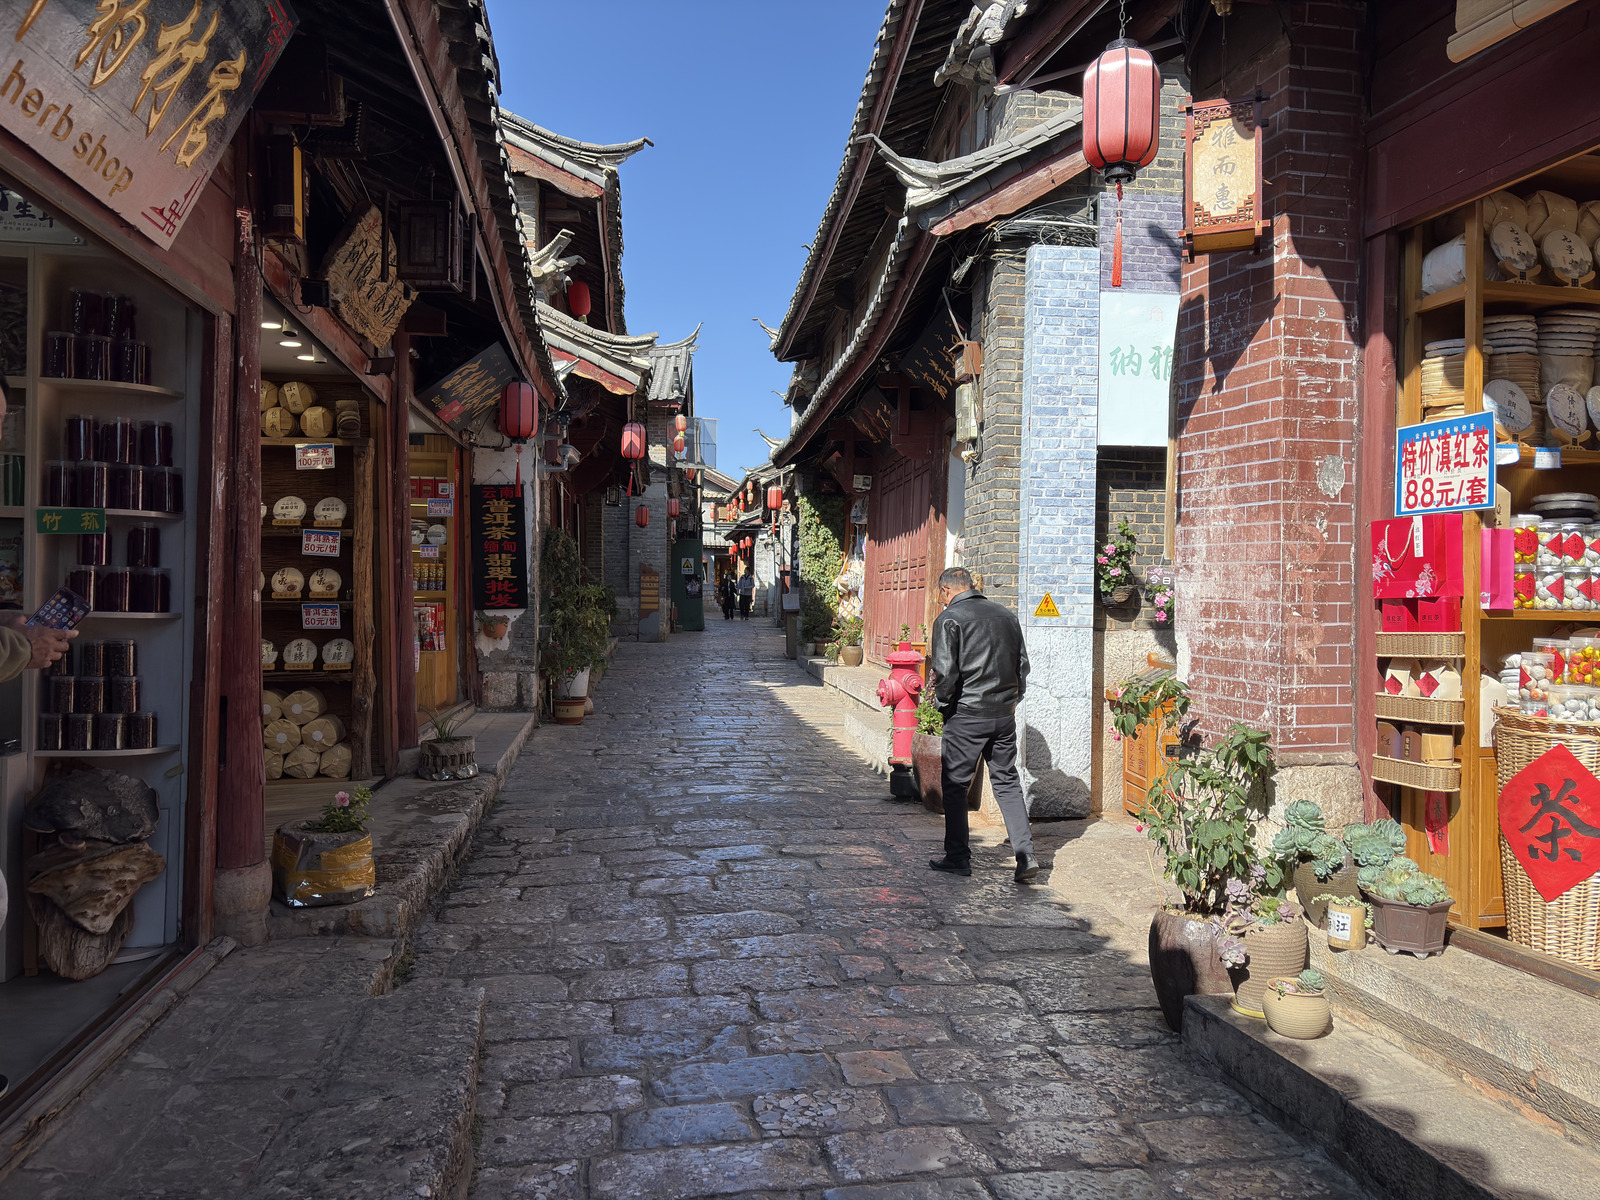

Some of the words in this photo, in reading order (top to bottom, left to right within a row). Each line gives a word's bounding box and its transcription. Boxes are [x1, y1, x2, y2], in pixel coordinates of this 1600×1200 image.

[14, 0, 248, 171] 药材店
[0, 59, 74, 142] herb
[72, 134, 135, 198] shop
[1211, 123, 1238, 212] 雅而惠
[297, 457, 334, 467] 100元/饼
[299, 447, 331, 457] 普洱茶
[1401, 425, 1489, 479] 特价滇红茶
[482, 487, 515, 499] 云南
[1405, 476, 1487, 510] 88元/套
[481, 498, 517, 540] 普洱茶
[303, 543, 338, 555] 80元/饼
[304, 532, 339, 544] 普洱熟茶
[483, 541, 517, 553] 缅甸
[483, 553, 518, 581] 翡翠
[485, 580, 519, 607] 批发
[303, 607, 338, 617] 普洱生茶
[304, 617, 338, 627] 60元/饼
[1430, 799, 1445, 844] 青柑
[1518, 777, 1600, 863] 茶
